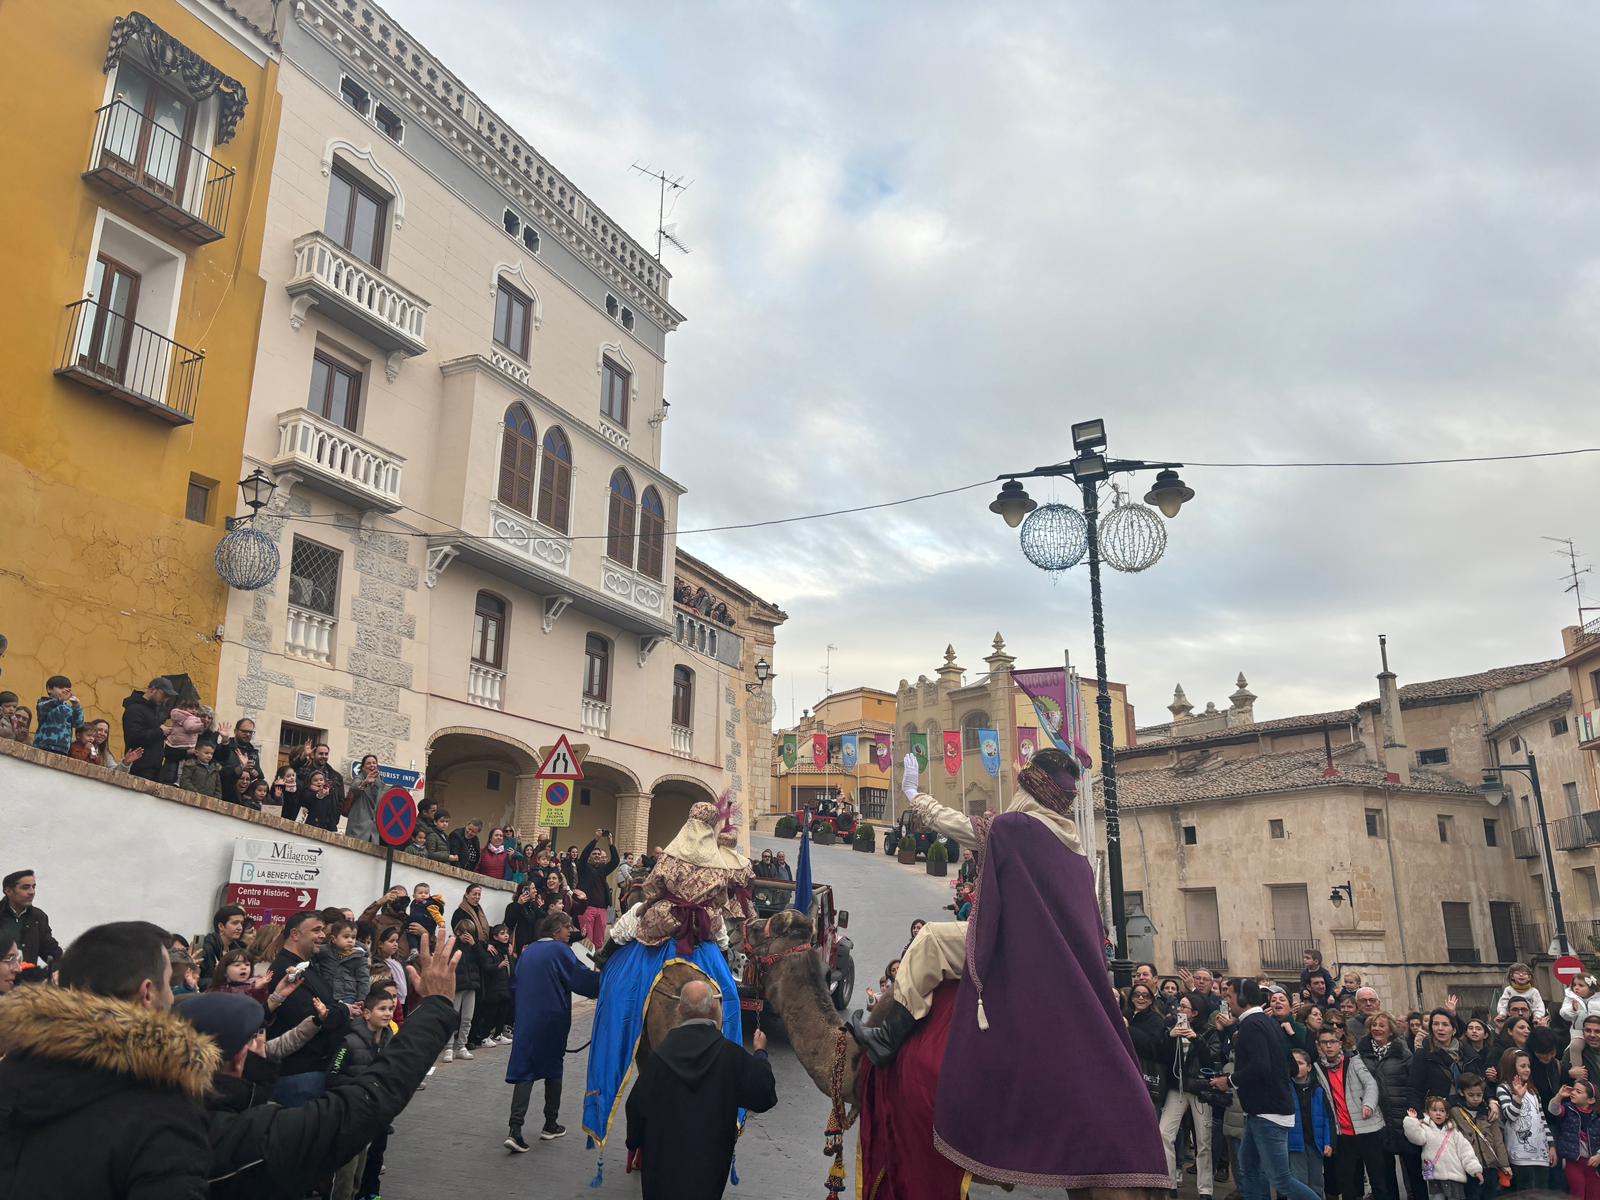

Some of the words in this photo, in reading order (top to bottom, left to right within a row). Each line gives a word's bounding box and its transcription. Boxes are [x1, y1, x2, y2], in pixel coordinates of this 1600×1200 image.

[379, 771, 400, 779] OURIST
[271, 842, 317, 863] Milagrosa
[237, 887, 262, 896] Centre
[247, 897, 260, 906] Vila
